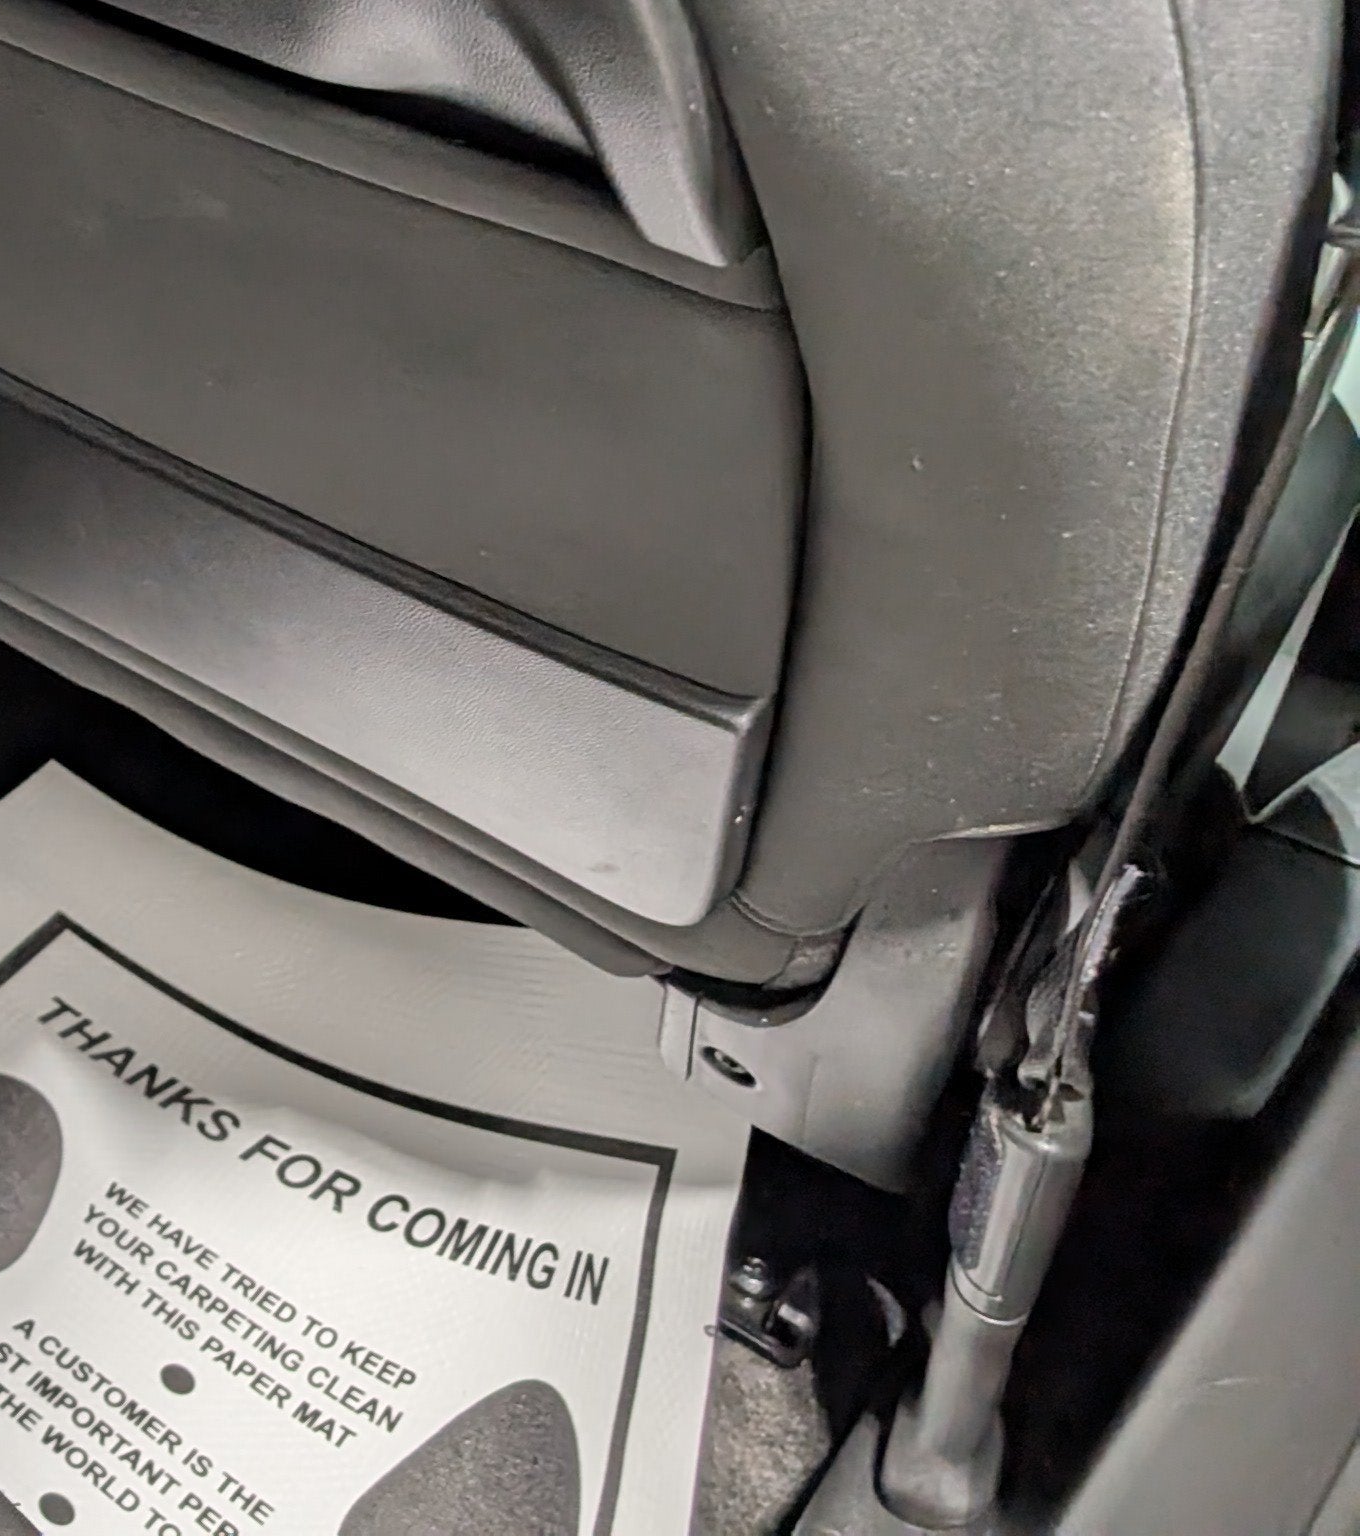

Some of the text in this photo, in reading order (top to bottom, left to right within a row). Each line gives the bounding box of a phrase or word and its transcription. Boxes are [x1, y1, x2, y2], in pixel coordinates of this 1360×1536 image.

[37, 996, 610, 1306] THANKS FOR COMING IN
[73, 1238, 357, 1448] WITH THIS PAPER MAT
[84, 1204, 404, 1433] YOUR CARPETING CLEAN
[105, 1182, 417, 1389] WE HAVE TRIED TO KEEP
[12, 1319, 275, 1526] A CUSTOMER IS THE
[25, 1370, 182, 1495] IMPORTANT
[41, 1424, 141, 1512] WORLD
[144, 1507, 182, 1536] TO
